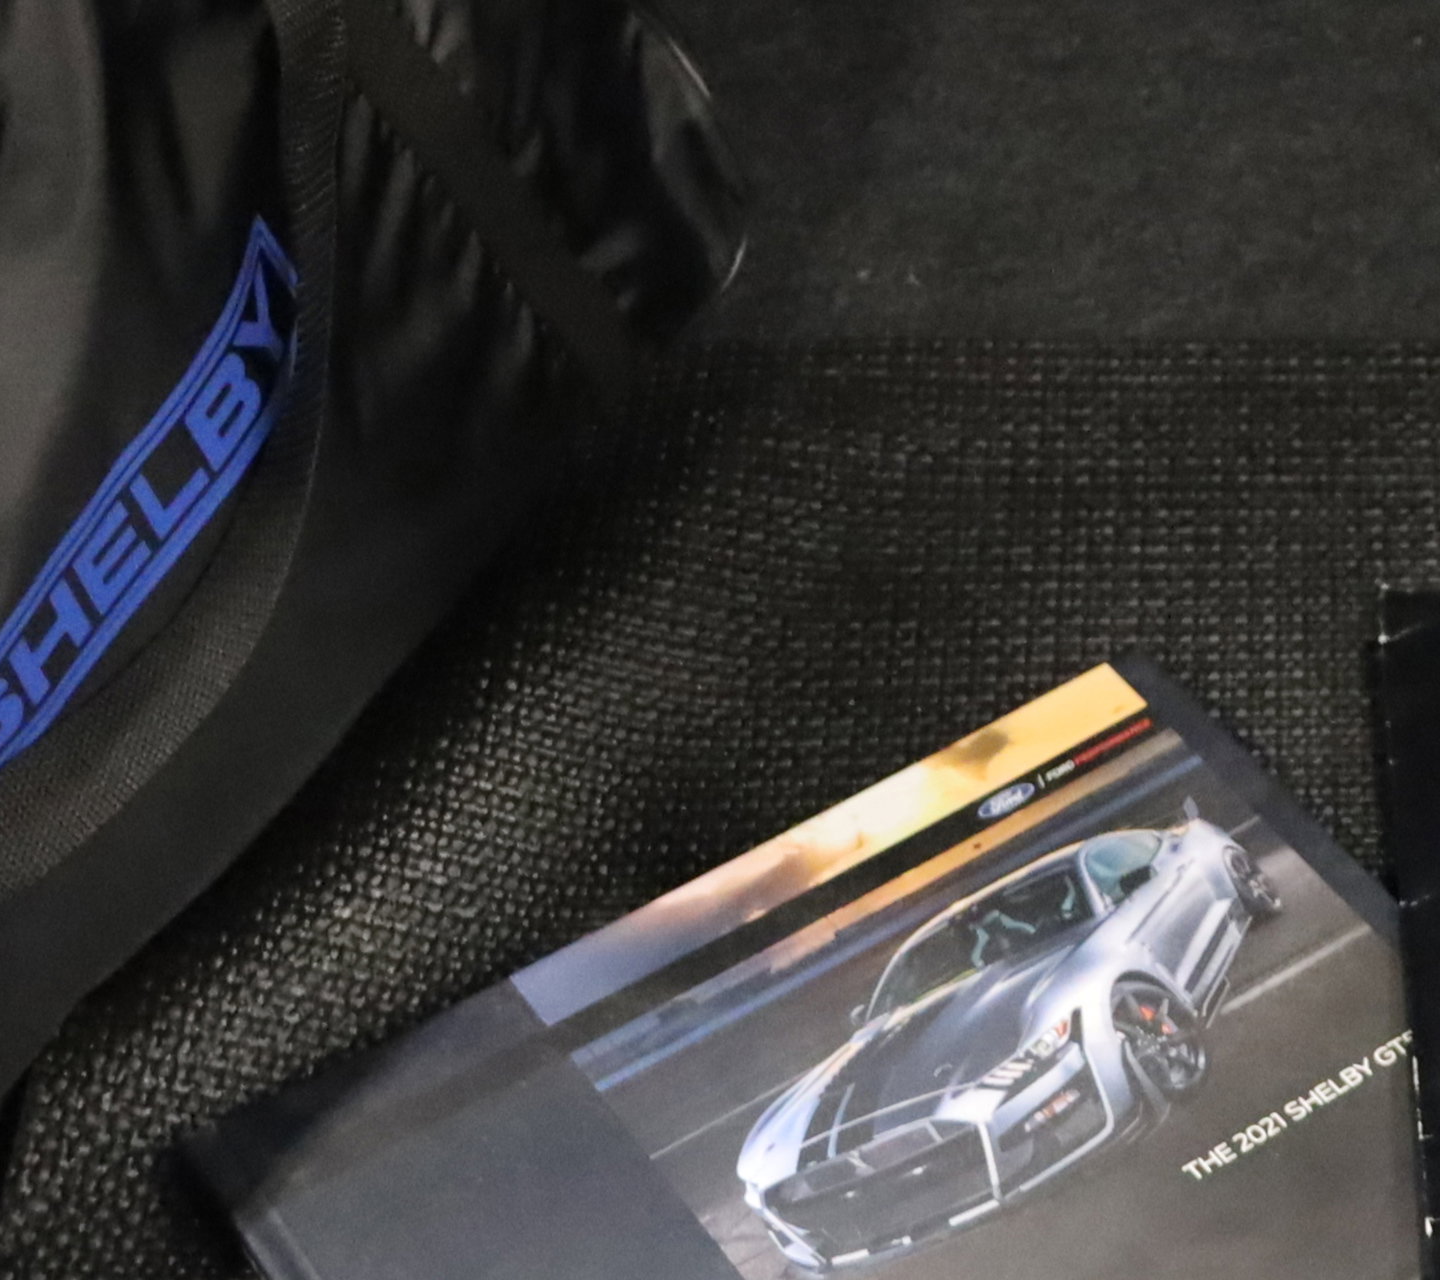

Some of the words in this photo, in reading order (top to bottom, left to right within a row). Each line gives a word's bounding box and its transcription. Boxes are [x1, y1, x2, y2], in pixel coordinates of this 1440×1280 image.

[1180, 1141, 1238, 1181] THE
[1231, 1111, 1288, 1154] 2021
[1283, 1056, 1374, 1123] SHELBY
